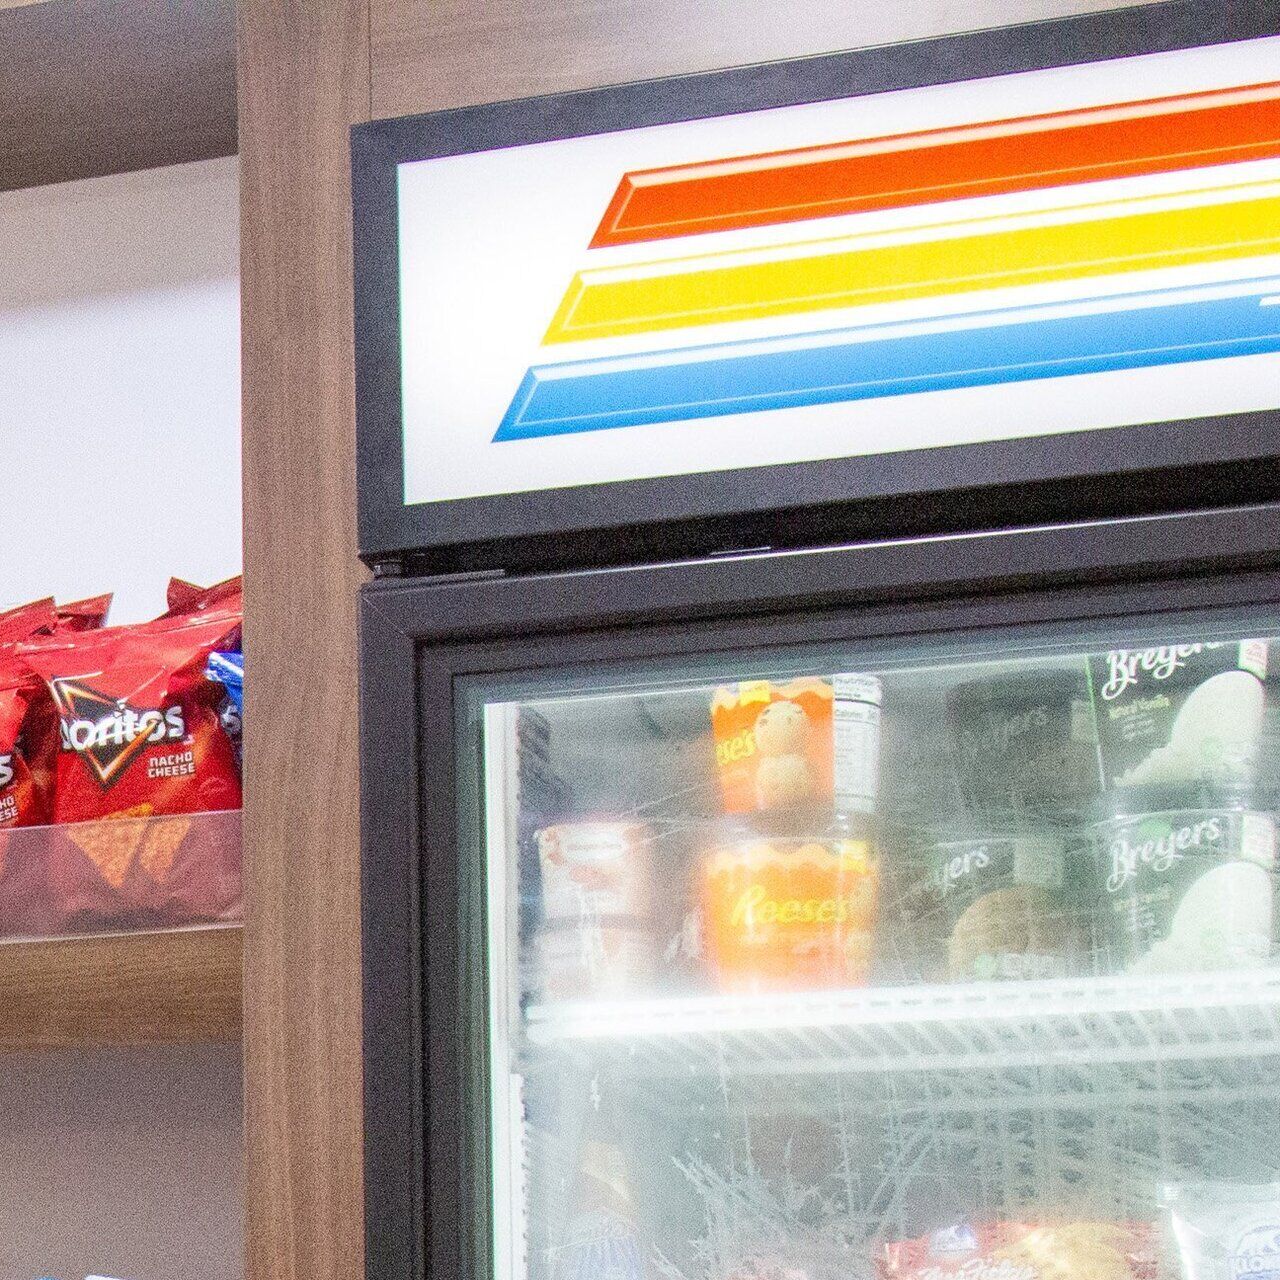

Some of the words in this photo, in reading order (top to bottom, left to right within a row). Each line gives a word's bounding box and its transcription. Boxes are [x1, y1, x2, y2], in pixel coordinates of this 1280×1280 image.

[60, 704, 185, 752] Doritos
[149, 752, 193, 768] NACHO
[149, 763, 196, 779] CHEESE
[1106, 817, 1220, 893] Breyers
